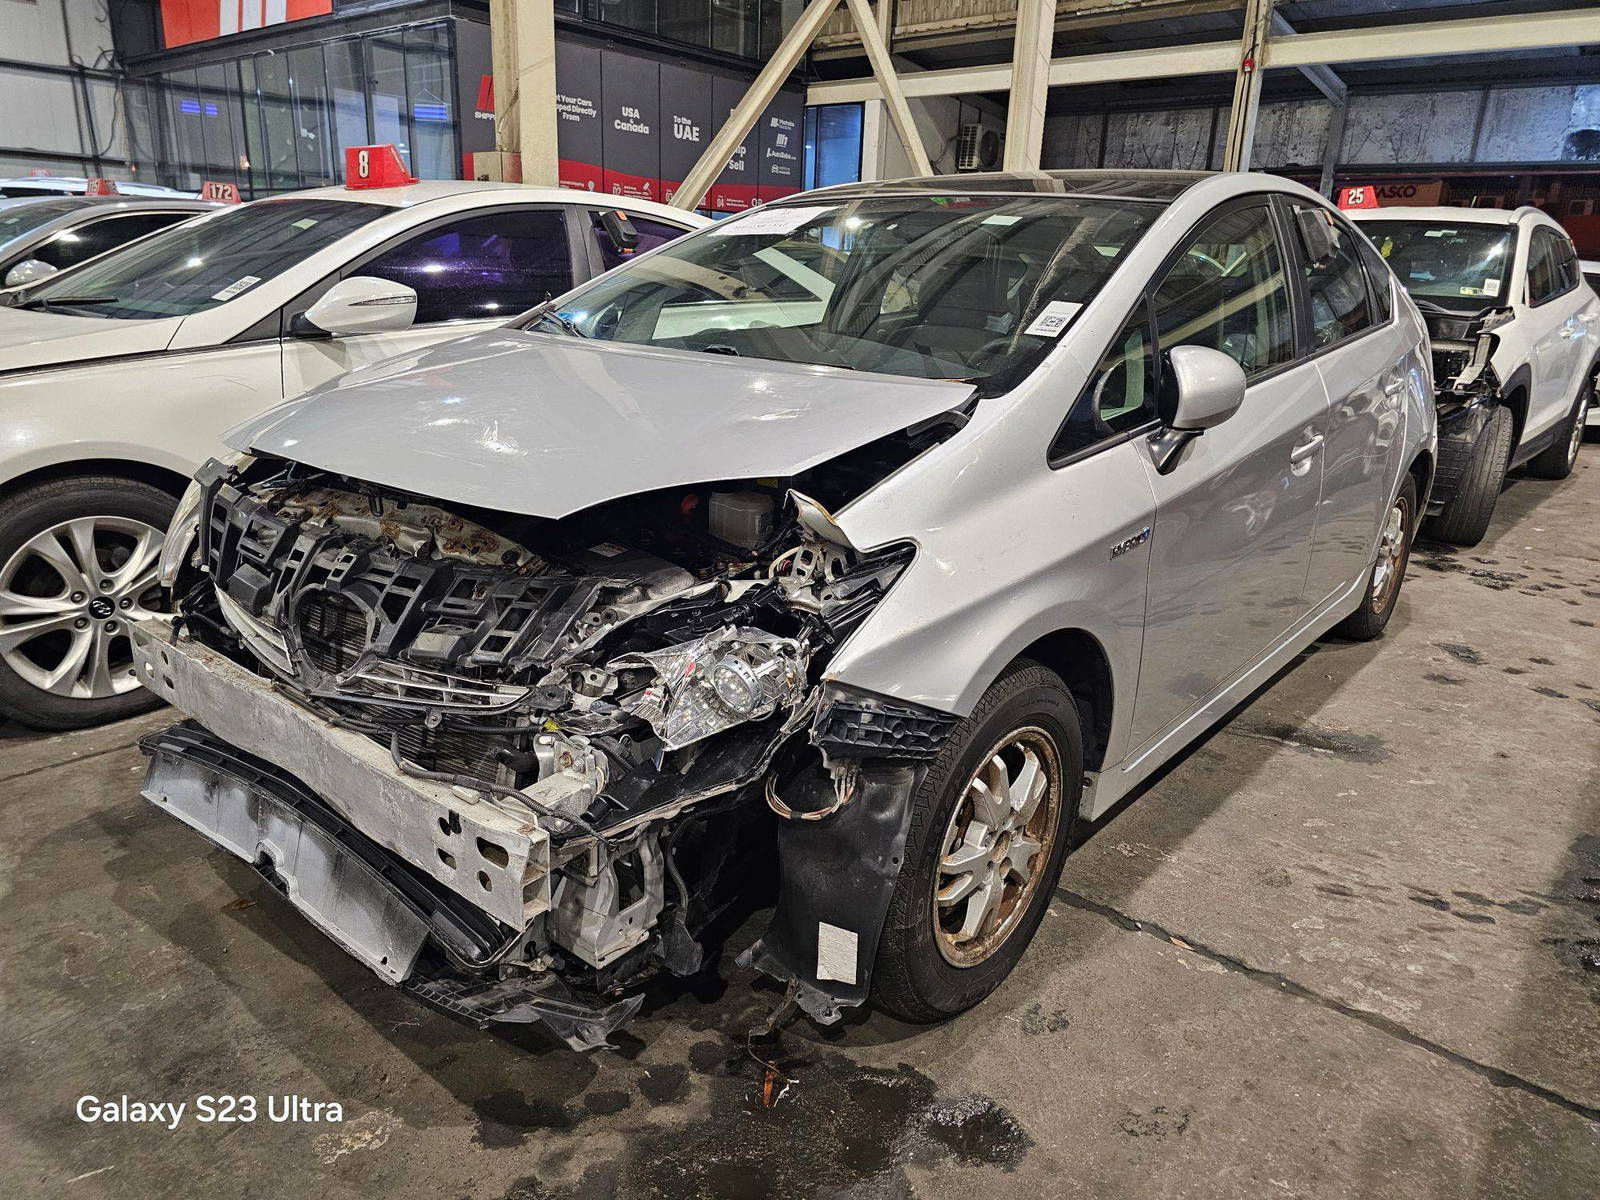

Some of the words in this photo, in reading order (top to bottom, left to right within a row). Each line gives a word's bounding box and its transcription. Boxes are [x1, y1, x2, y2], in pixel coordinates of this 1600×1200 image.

[561, 94, 576, 104] Your
[577, 97, 593, 107] Cars
[474, 111, 497, 120] SHIPP
[562, 112, 580, 122] From
[572, 105, 597, 118] Directly
[622, 106, 640, 119] USA
[614, 119, 650, 134] Canada
[673, 115, 681, 124] To
[681, 117, 692, 125] the
[673, 123, 700, 142] UAE
[358, 150, 369, 178] 8
[729, 159, 745, 171] Sell
[209, 183, 233, 200] 172
[1348, 187, 1364, 205] 25
[1375, 185, 1417, 199] ASCO
